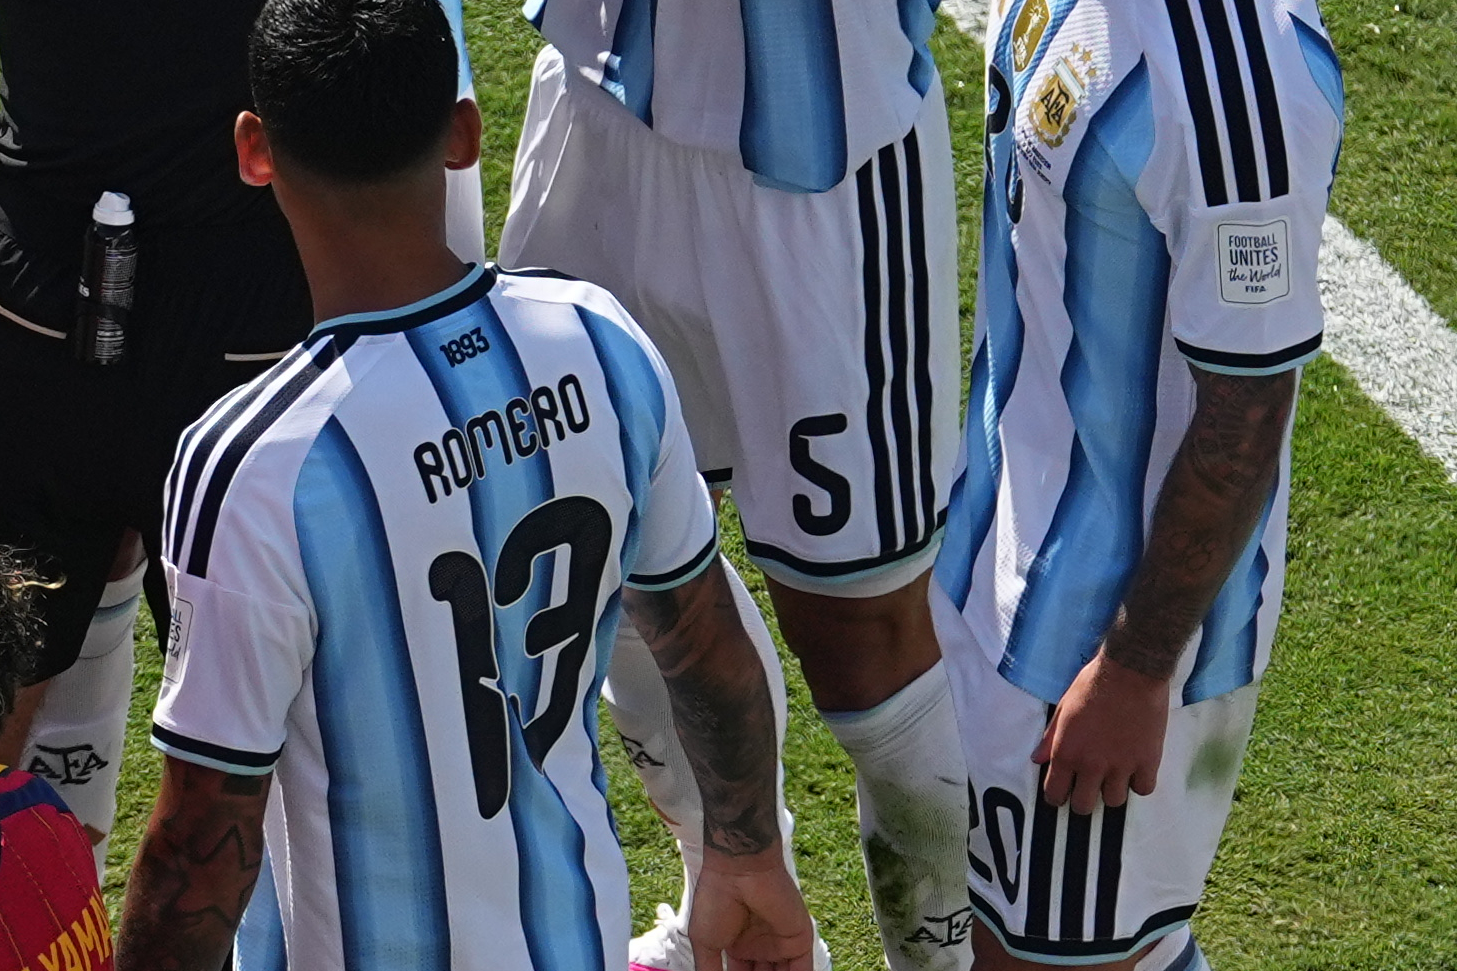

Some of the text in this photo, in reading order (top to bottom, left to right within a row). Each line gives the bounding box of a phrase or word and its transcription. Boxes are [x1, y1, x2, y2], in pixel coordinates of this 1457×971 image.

[1039, 80, 1071, 129] AFA
[1228, 232, 1279, 249] FOOTBALL
[1229, 246, 1279, 266] UNITES
[1227, 262, 1282, 283] the World
[1245, 285, 1267, 293] FIFA
[439, 326, 491, 369] 1893
[412, 372, 592, 505] ROMERO
[788, 412, 853, 537] 5
[27, 743, 109, 786] AFA
